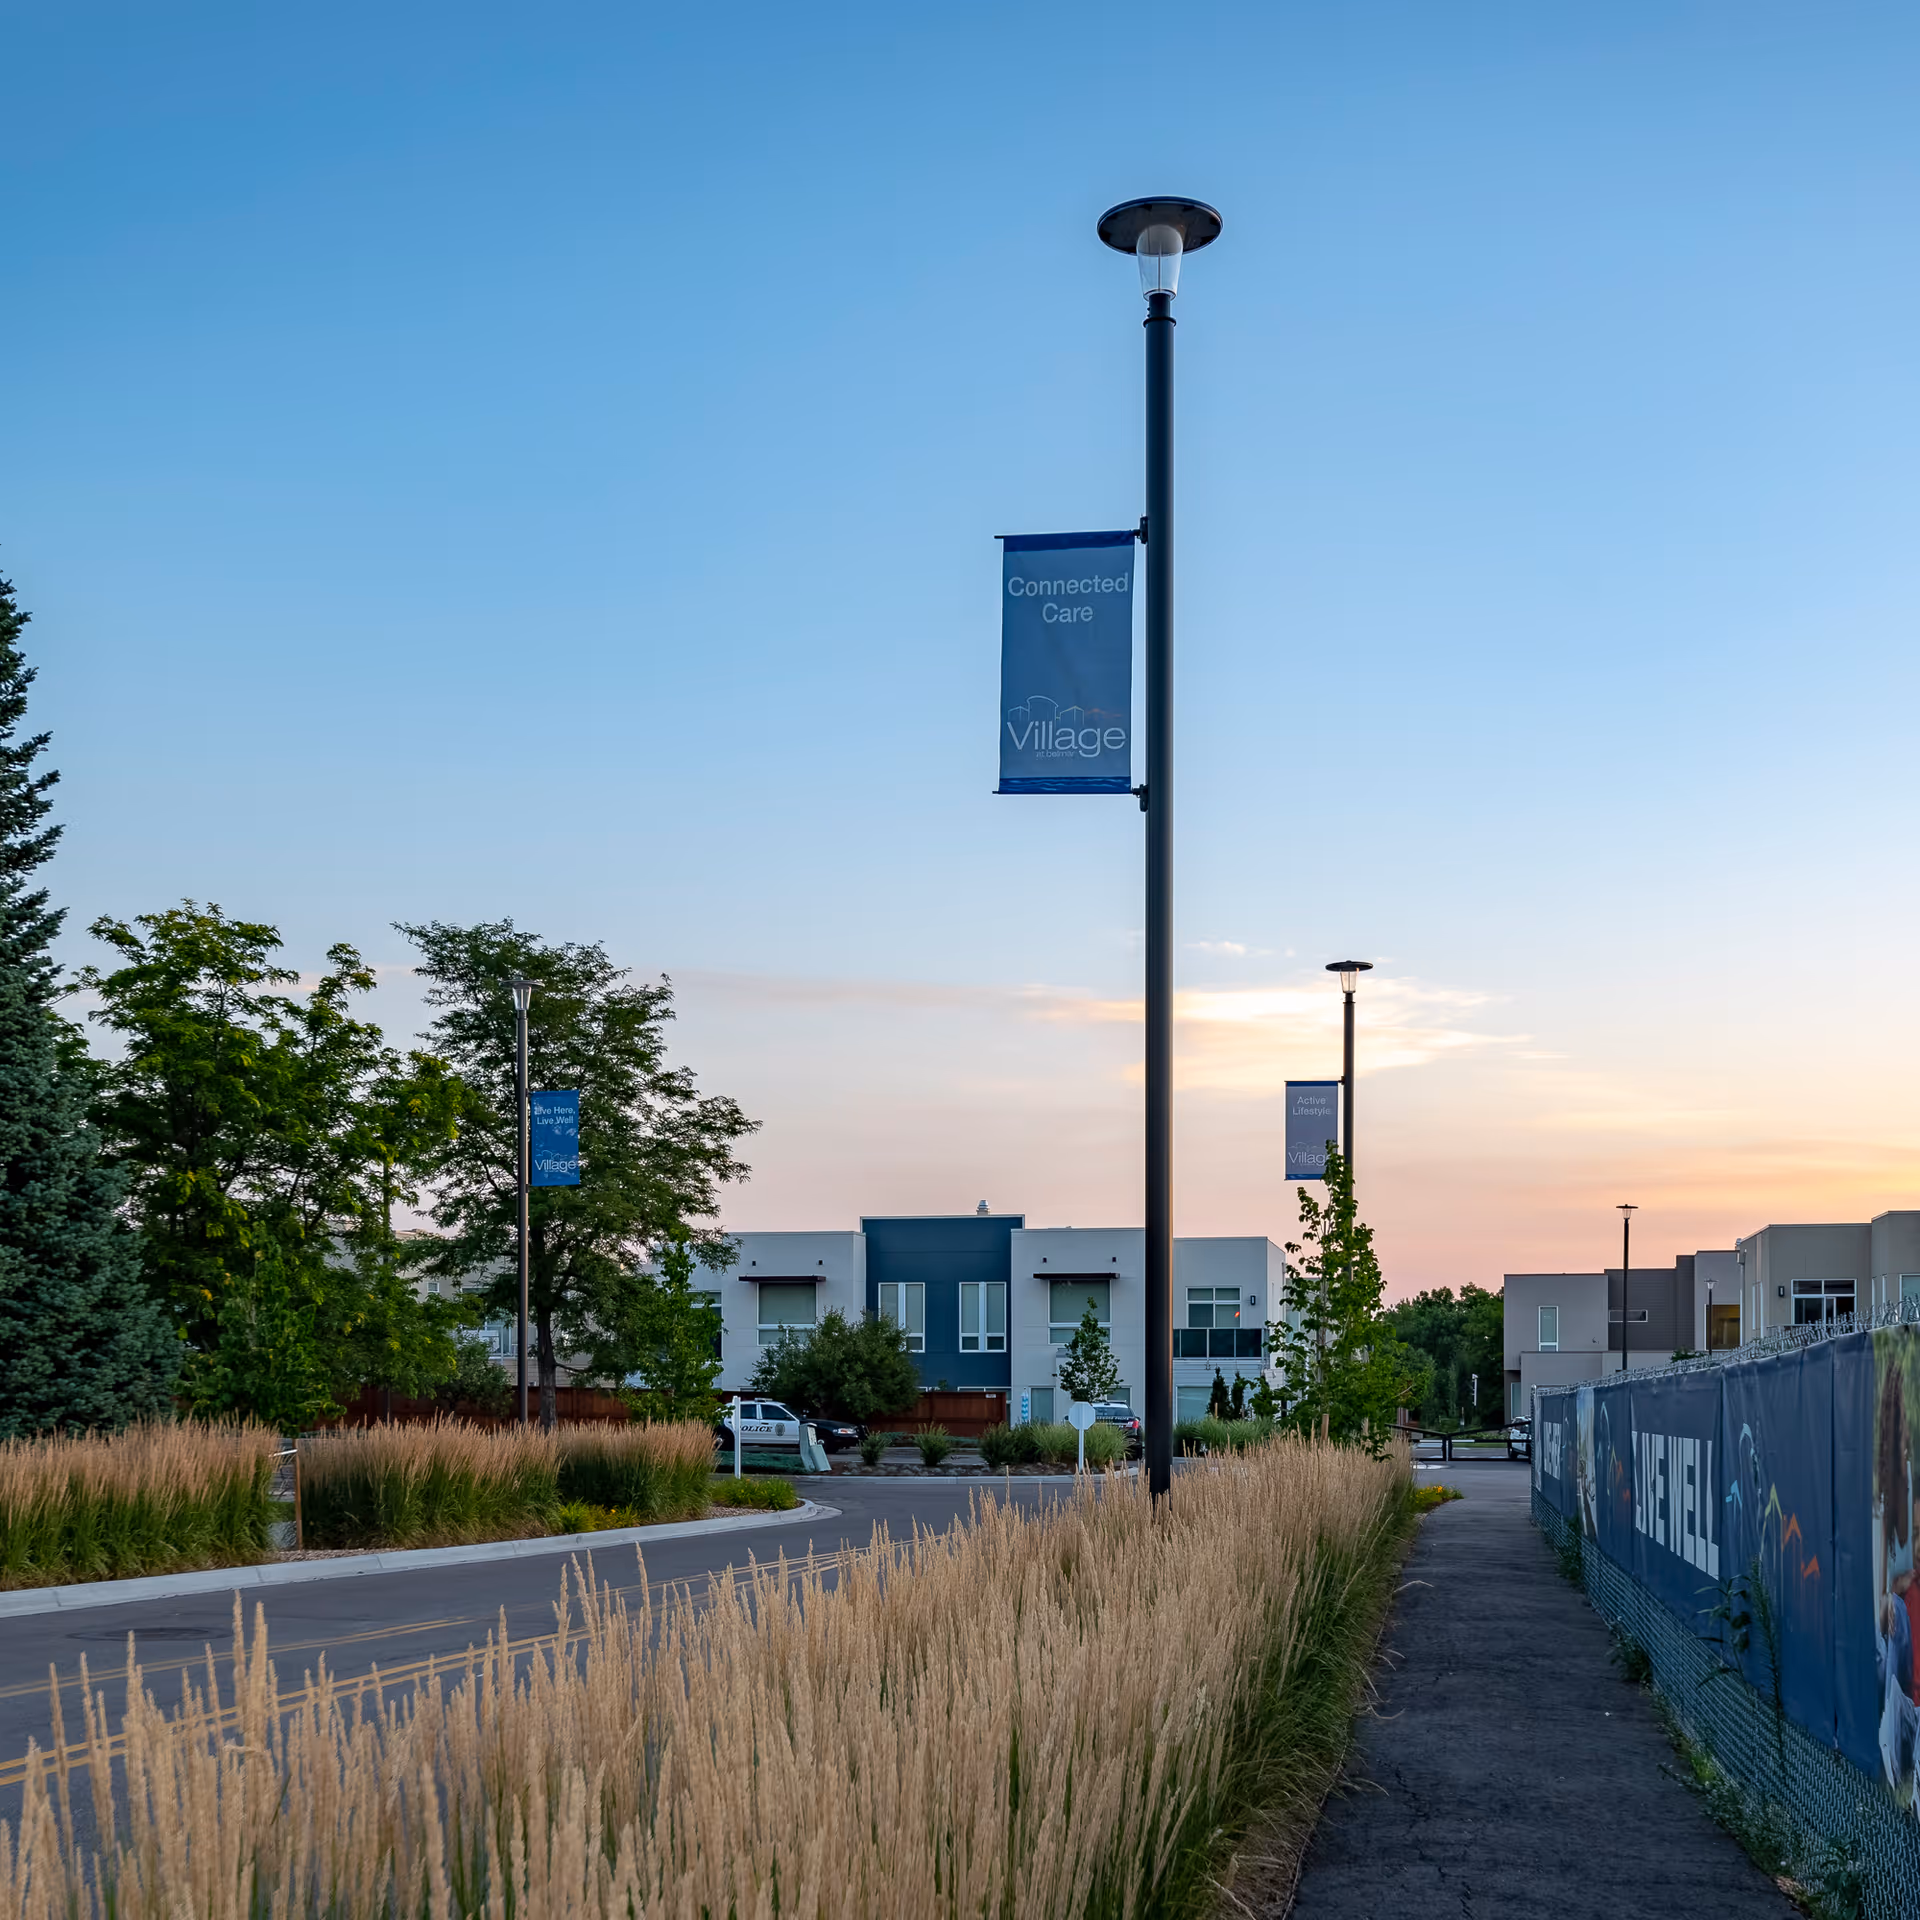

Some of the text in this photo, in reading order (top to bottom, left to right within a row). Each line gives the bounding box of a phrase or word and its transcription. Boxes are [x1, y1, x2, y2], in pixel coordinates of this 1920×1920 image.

[1008, 572, 1128, 597] Connected
[1042, 602, 1094, 623] Care
[1007, 720, 1127, 758] Village
[1296, 1096, 1327, 1105] Active
[534, 1106, 552, 1115] Live
[1292, 1106, 1332, 1117] Lifestyle
[536, 1115, 574, 1124] Live Well
[534, 1159, 577, 1172] Village
[740, 1425, 773, 1433] OLICE
[1631, 1430, 1720, 1582] LIVE WELL
